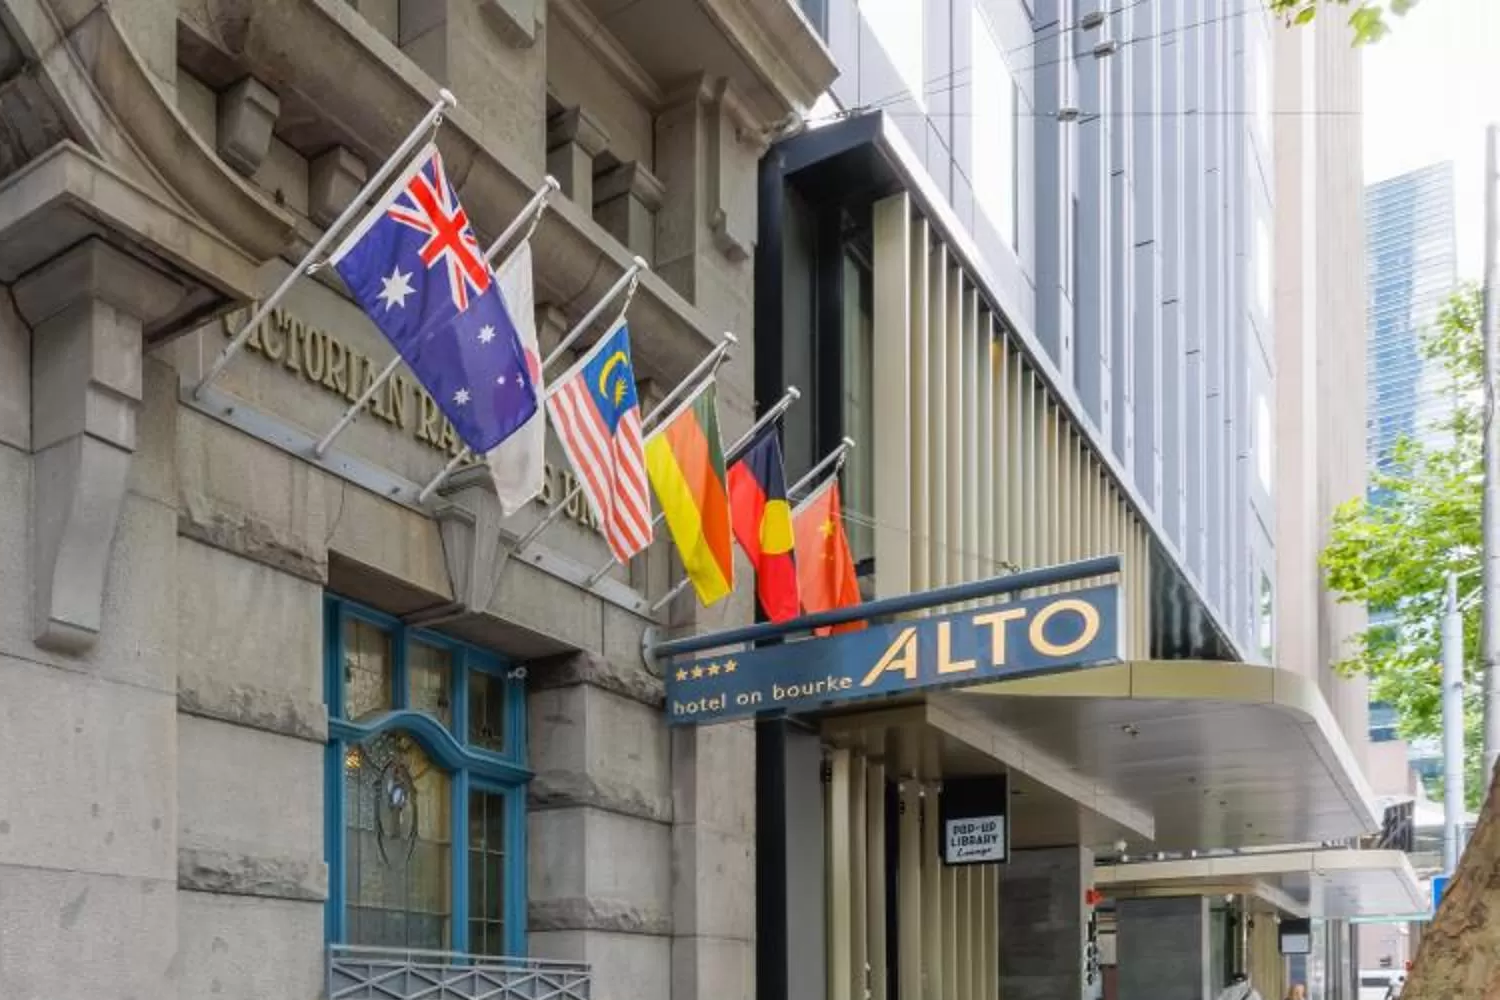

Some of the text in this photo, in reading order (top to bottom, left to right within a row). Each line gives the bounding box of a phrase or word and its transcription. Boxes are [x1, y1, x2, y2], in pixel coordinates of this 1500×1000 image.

[860, 599, 1101, 687] ALTO
[673, 675, 853, 715] hotel on bourke
[950, 834, 998, 848] LIBRARY
